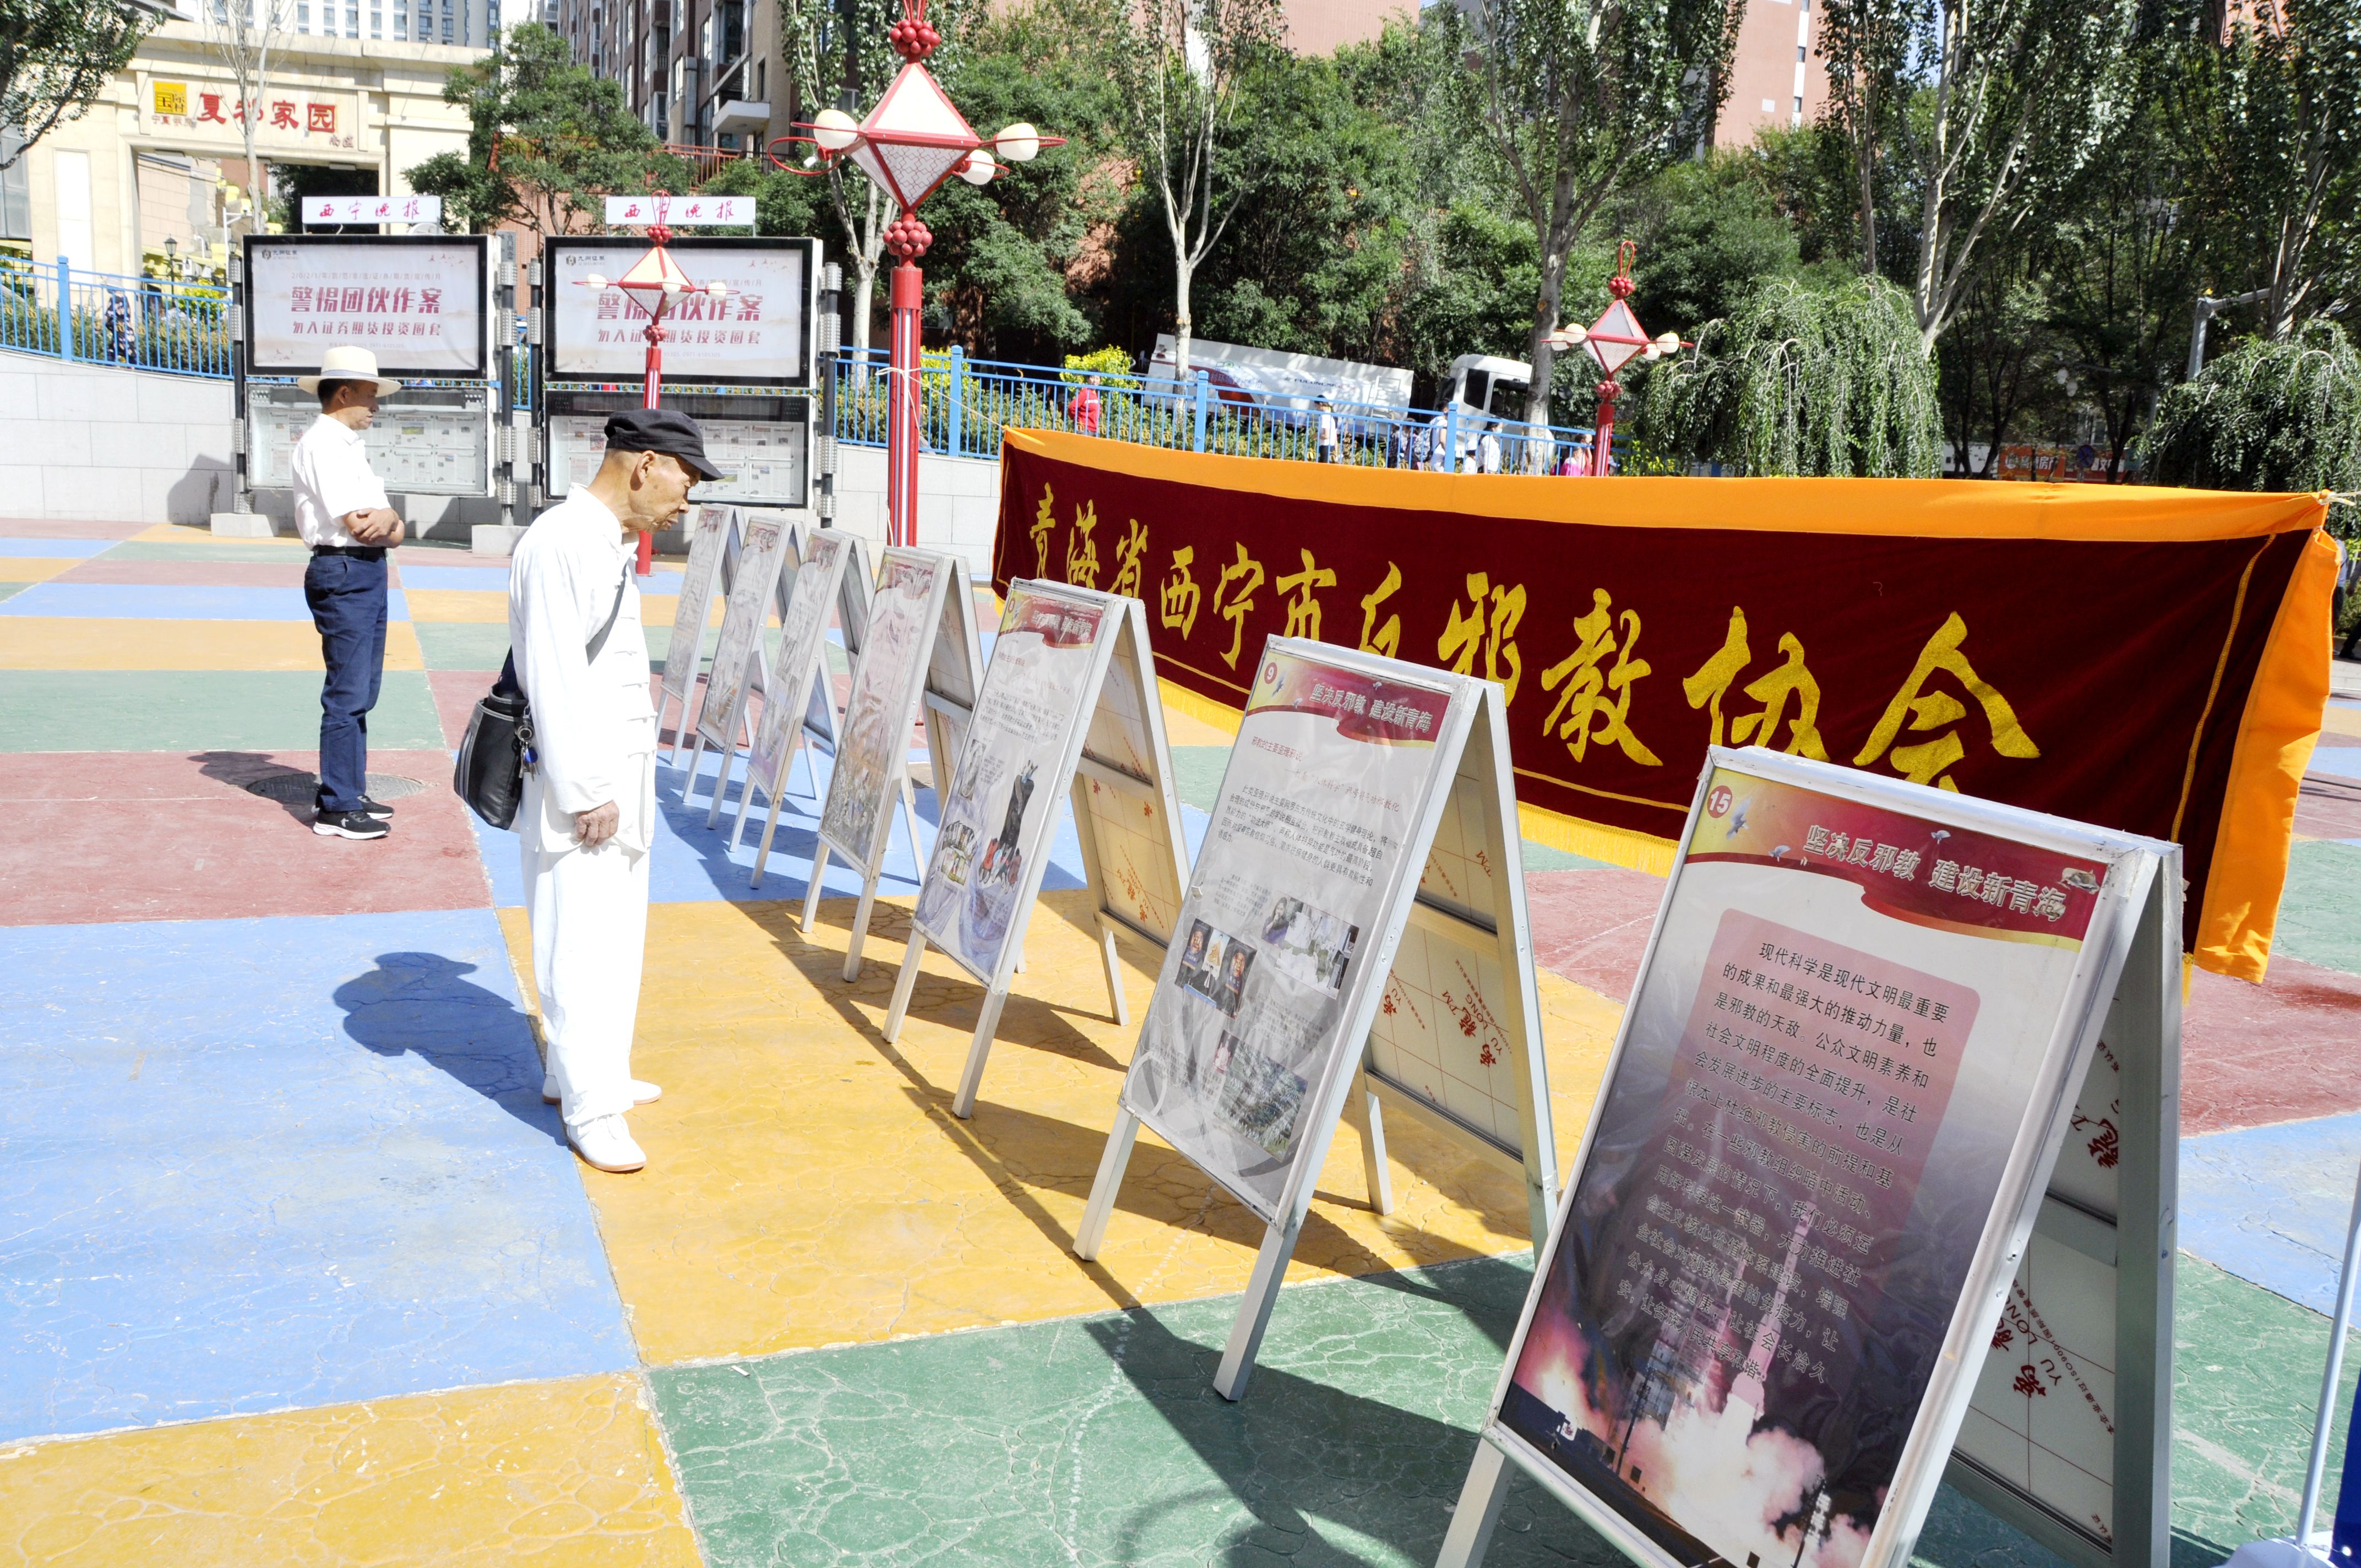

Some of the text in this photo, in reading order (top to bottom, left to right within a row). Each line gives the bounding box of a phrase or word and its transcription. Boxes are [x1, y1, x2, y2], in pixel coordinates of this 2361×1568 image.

[319, 199, 421, 220] 西宁晚报
[291, 286, 442, 313] 警惕团伙作案
[292, 321, 441, 336] 勿入证券期货投资圈套
[597, 328, 761, 345] 勿入证期货投资圈套
[1029, 481, 2041, 793] 青海省西宁市反邪教协会
[1266, 667, 1275, 680] 9
[1251, 736, 1303, 762] 邪教的主要歪理邪说
[1309, 683, 1433, 733] 坚决反邪教 建设新青海
[1709, 790, 1731, 814] 15
[1803, 825, 2068, 922] 坚决反邪教 建设新青海
[1465, 994, 1503, 1056] YU LONG
[1722, 962, 1938, 1058] 的成果和最强大的推动力量，也
[1759, 942, 1950, 1024] 现代科学是现代文明最重要
[1705, 1020, 1918, 1124] 社会文明程度的全面提升，是社
[1713, 992, 1929, 1090] 是邪教的天敌。公众文明素养和
[1685, 1077, 1895, 1190] 根本上杜绝邪教侵害的前提和基
[1694, 1050, 1903, 1157] 会发展进步的主要标志，也是从
[1663, 1135, 1873, 1256] 图谋发展的情况下，我们必须运
[1674, 1108, 1872, 1219] 础。在一些邪教组织暗中活动、
[1646, 1194, 1850, 1321] 会主义核心价值体系建设，增强
[1654, 1164, 1862, 1288] 用好科学这一武器，大力推进社
[1617, 1279, 1764, 1384] 安，让各族人民共享和谐。
[1628, 1251, 1826, 1384] 公众身心健康，让社会长治久
[1636, 1222, 1839, 1353] 全社会对邪教侵害的免疫力，让
[2004, 1294, 2062, 1386] YU LON
